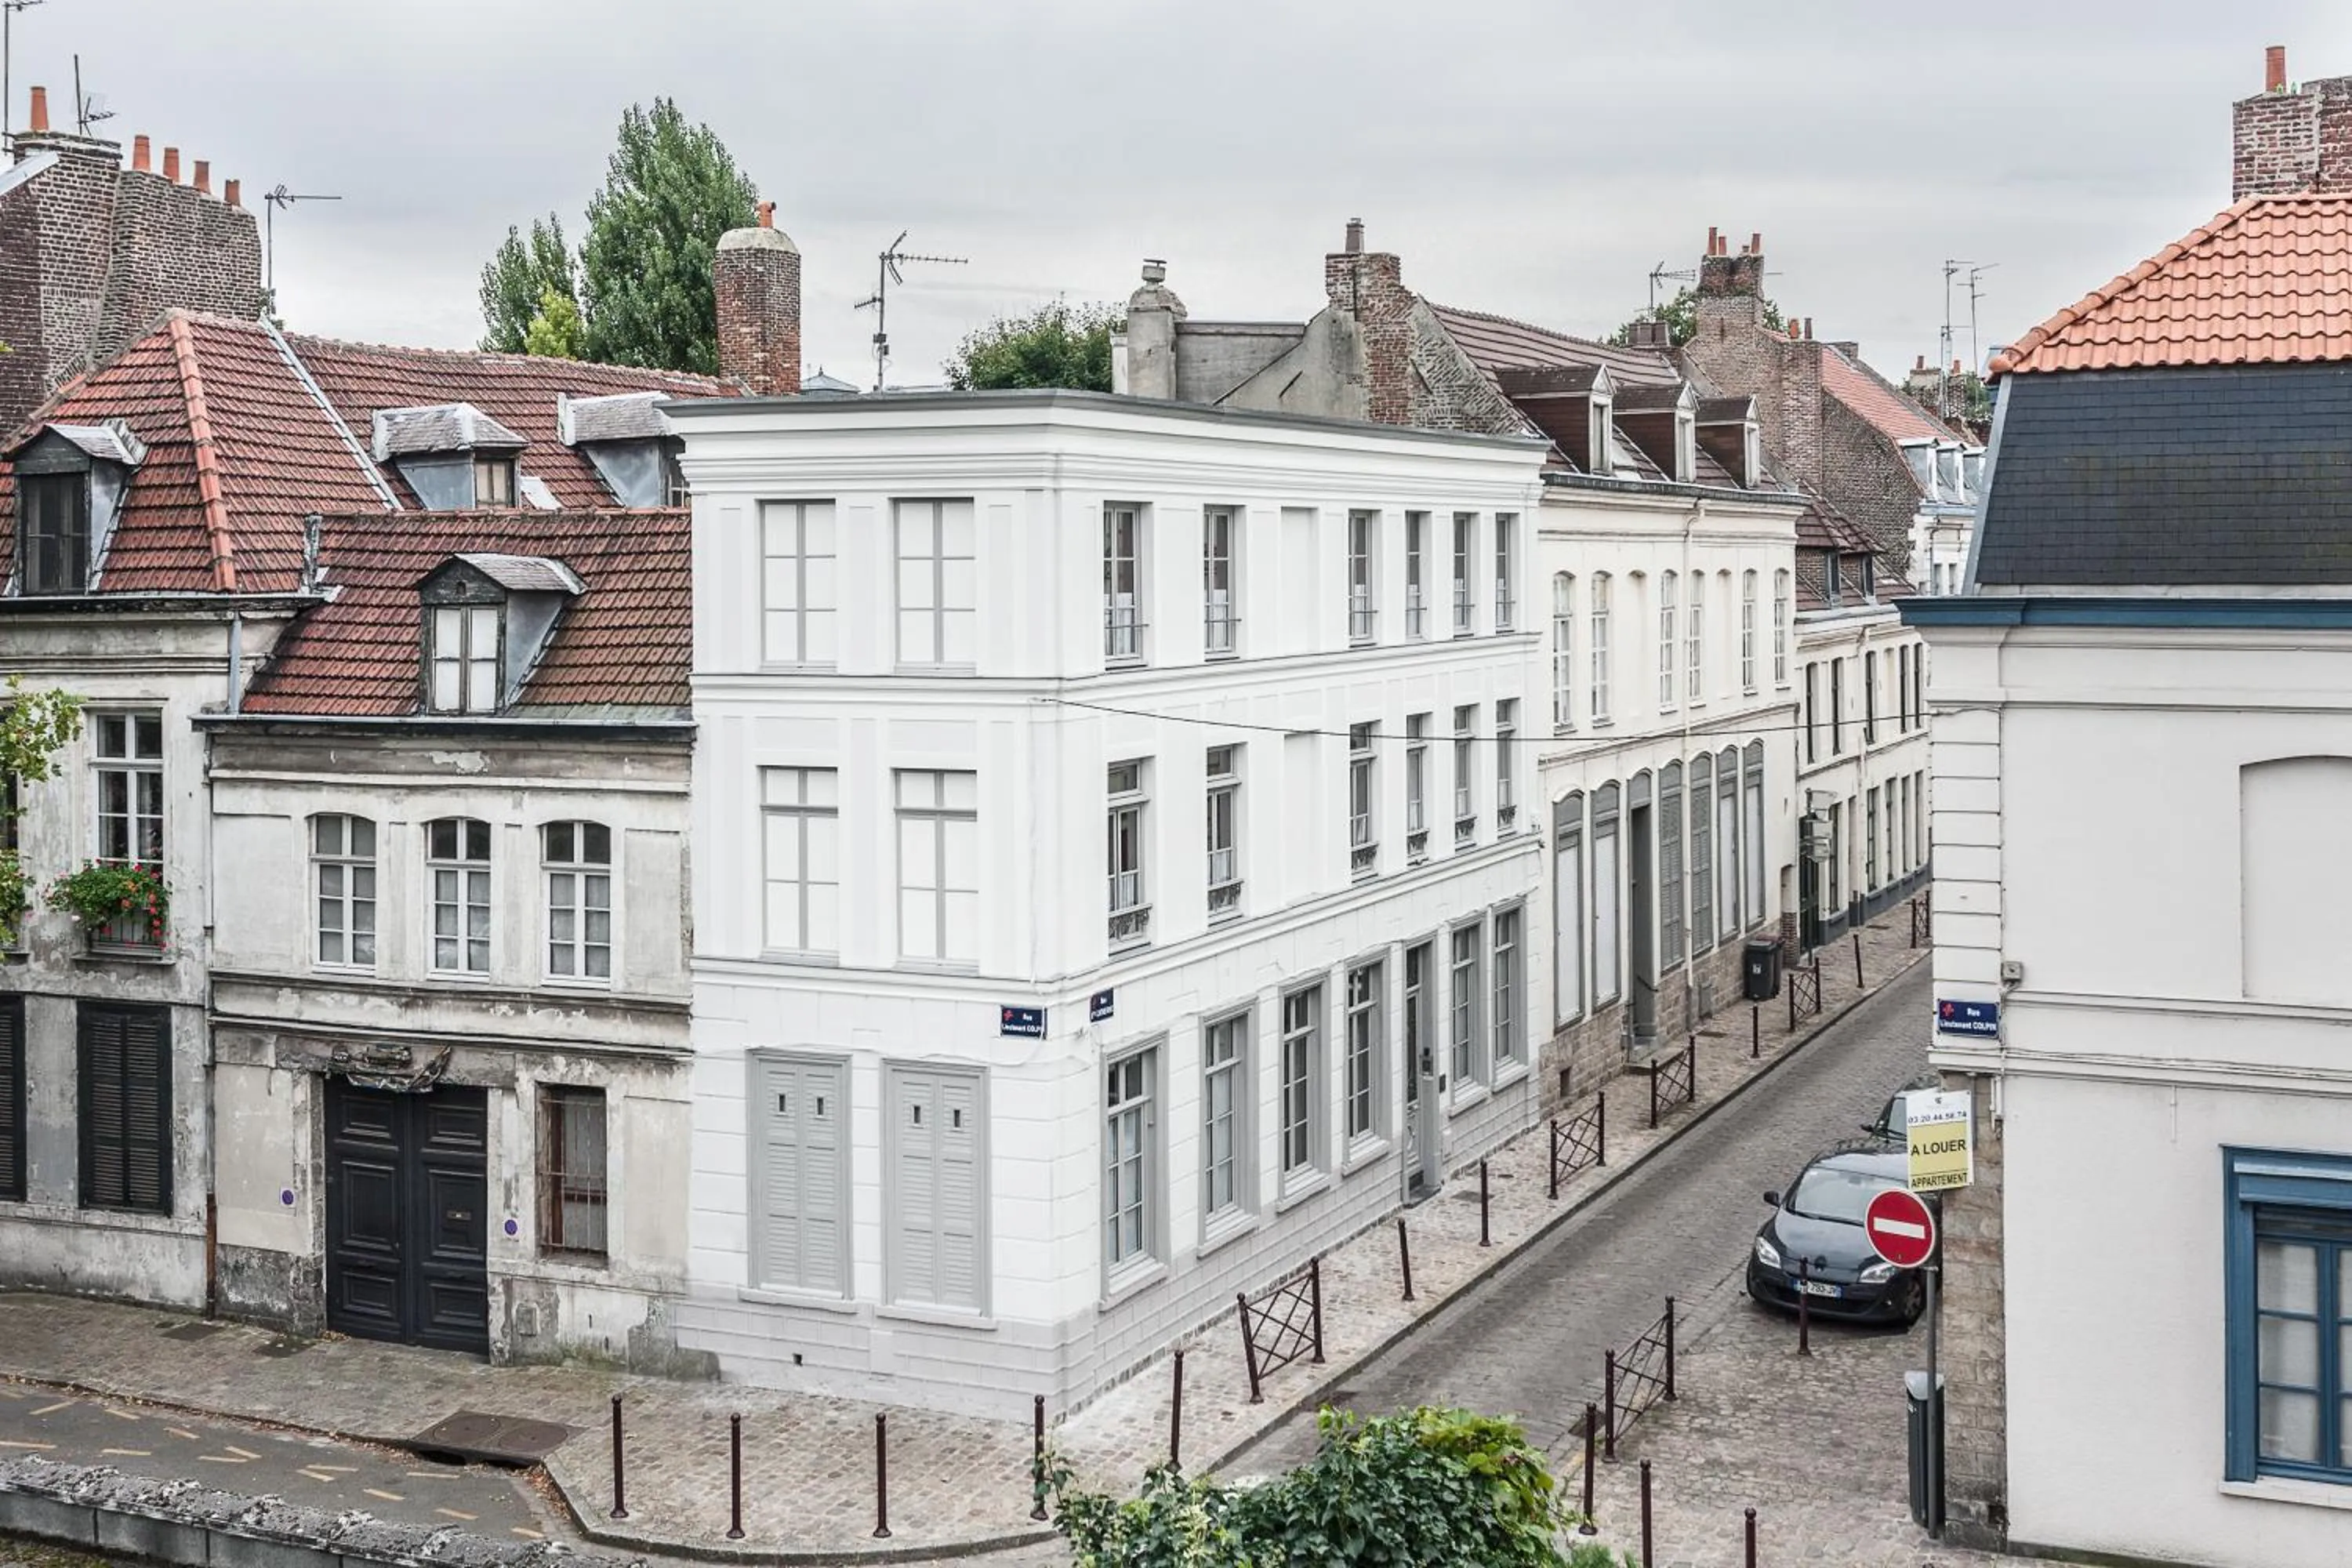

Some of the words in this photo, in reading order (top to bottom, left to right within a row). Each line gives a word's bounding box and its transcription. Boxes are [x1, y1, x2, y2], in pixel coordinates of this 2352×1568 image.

[1967, 1007, 1980, 1017] Rue
[1911, 1144, 1920, 1156] A
[1923, 1139, 1966, 1155] LOUER
[1911, 1172, 1967, 1187] APPARTEMENT
